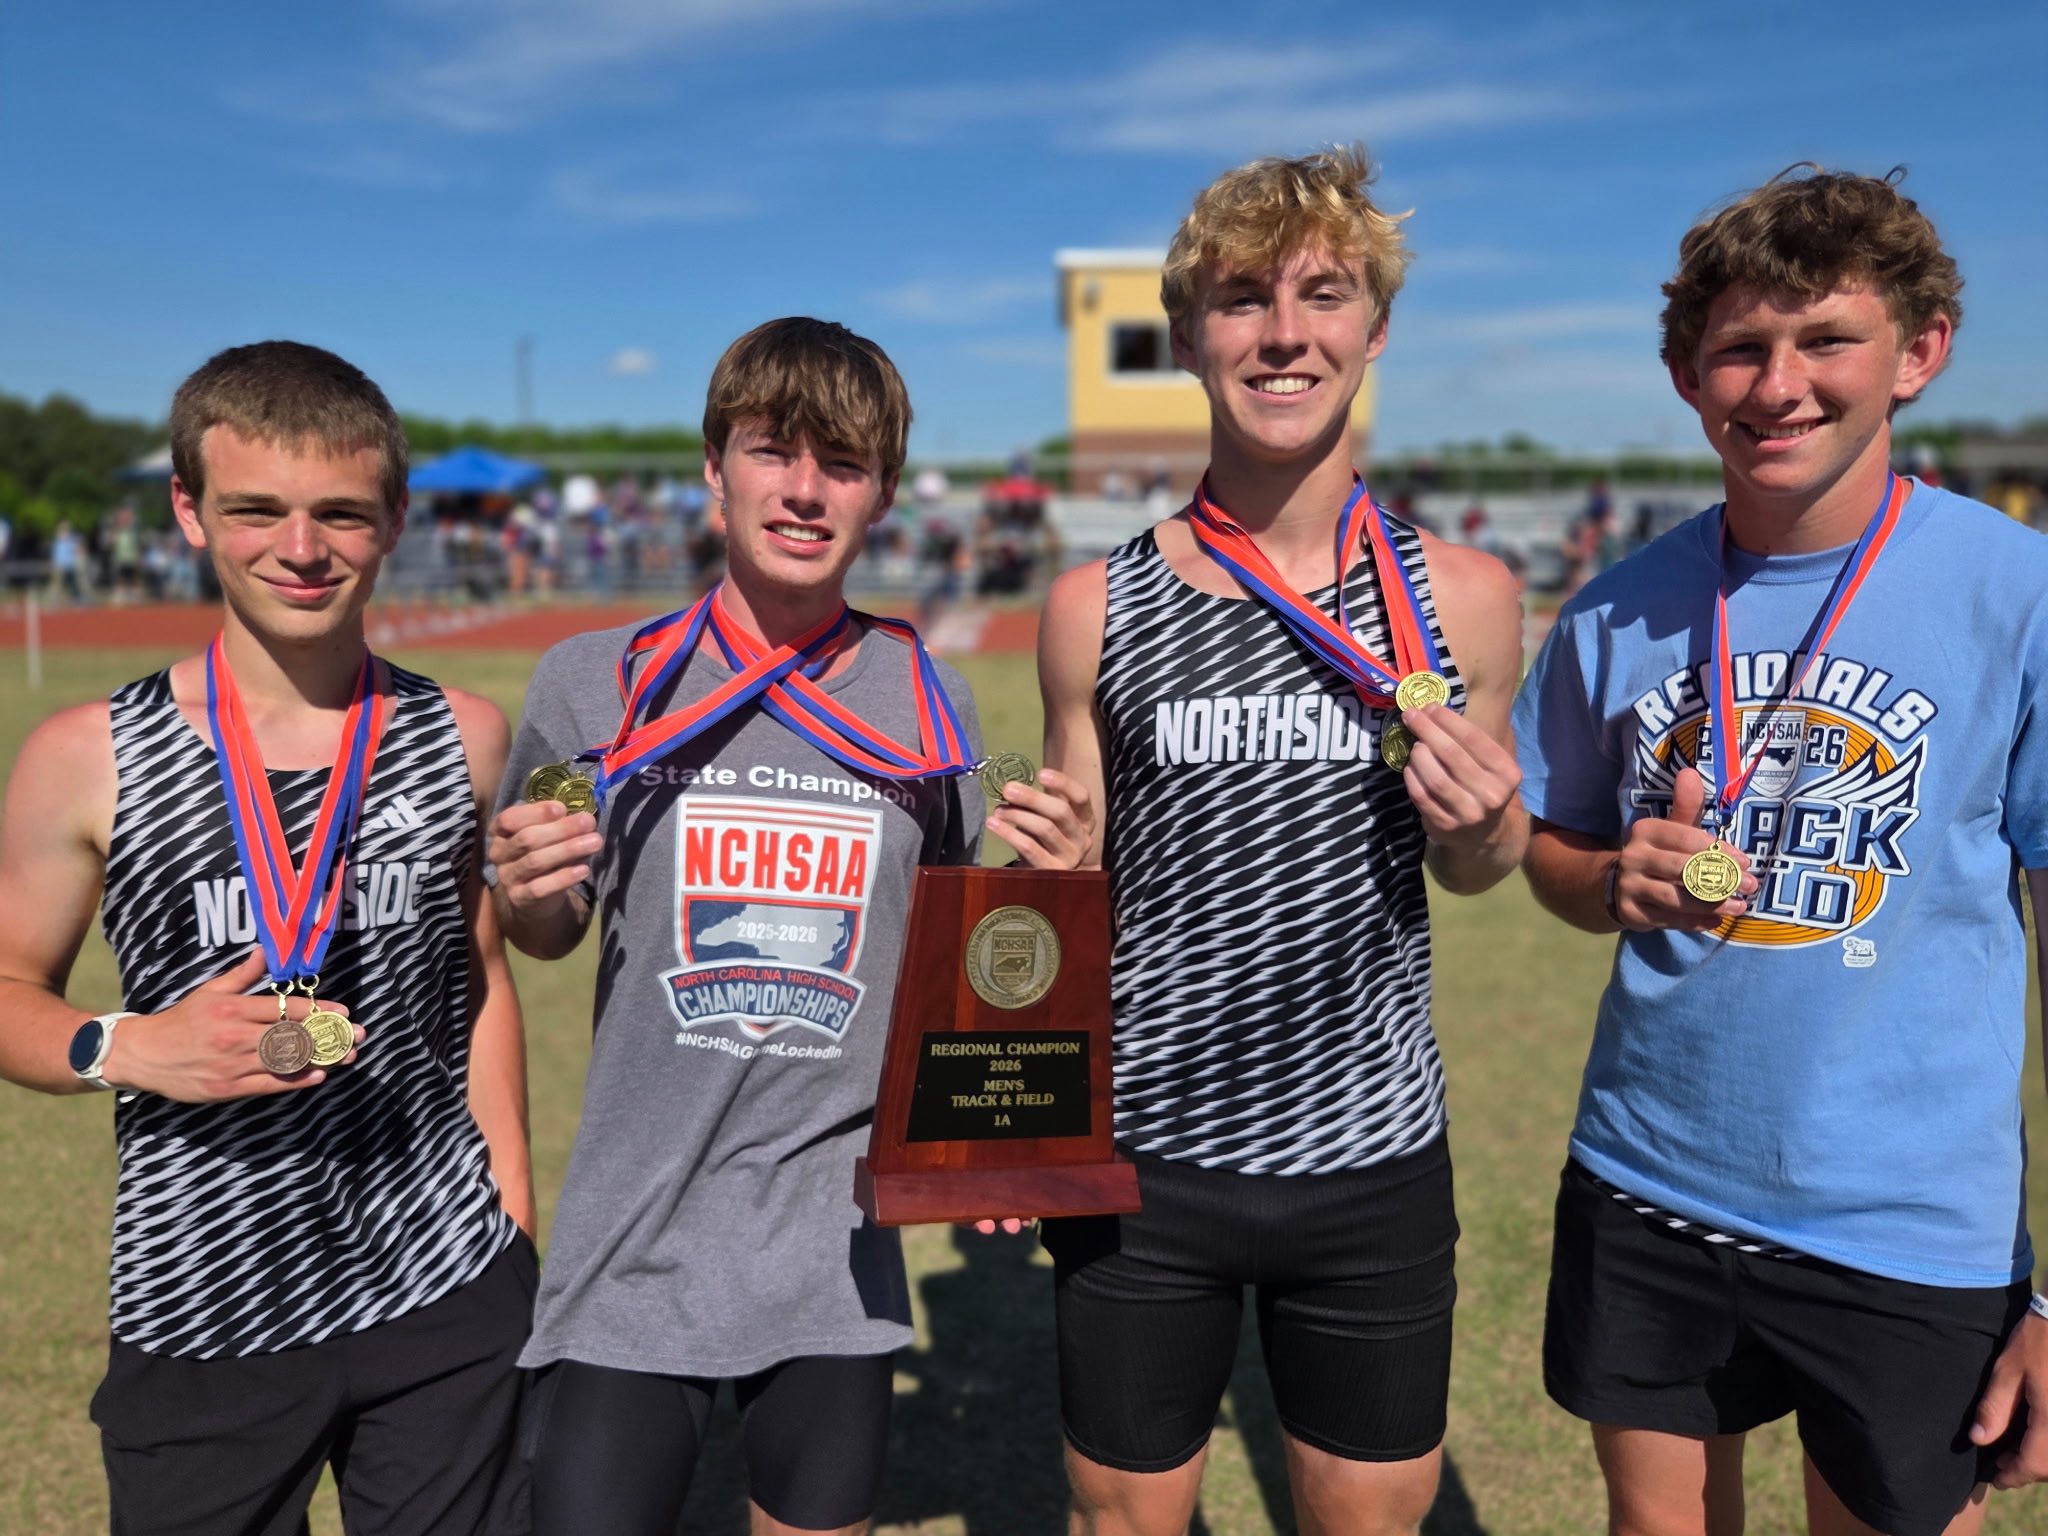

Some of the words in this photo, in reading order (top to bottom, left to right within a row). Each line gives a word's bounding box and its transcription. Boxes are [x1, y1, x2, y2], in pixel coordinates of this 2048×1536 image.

[1155, 693, 1384, 767] NORTHSIDE
[1806, 726, 1848, 767] 26
[641, 764, 737, 787] State
[749, 766, 916, 809] Champion
[685, 827, 867, 898] NCHSAA
[193, 861, 430, 948] NOSIDE
[737, 922, 818, 944] 2025-2026
[994, 936, 1035, 951] NCHSAA
[674, 970, 715, 988] NORTH
[718, 967, 782, 982] CAROLINA
[787, 971, 816, 988] HIGH
[817, 978, 856, 1001] SCHOOL
[679, 982, 849, 1028] CHAMPIONSHIPS
[676, 1032, 842, 1060] #NCHSAGeLockedIn
[931, 1043, 1004, 1057] REGIONAL
[1007, 1042, 1080, 1056] CHAMPION
[989, 1060, 1022, 1072] 2026
[984, 1080, 1025, 1092] MEN'S
[951, 1095, 997, 1108] TRACK
[1001, 1095, 1012, 1106] &
[1016, 1094, 1055, 1106] FIELD
[994, 1115, 1011, 1127] 1A
